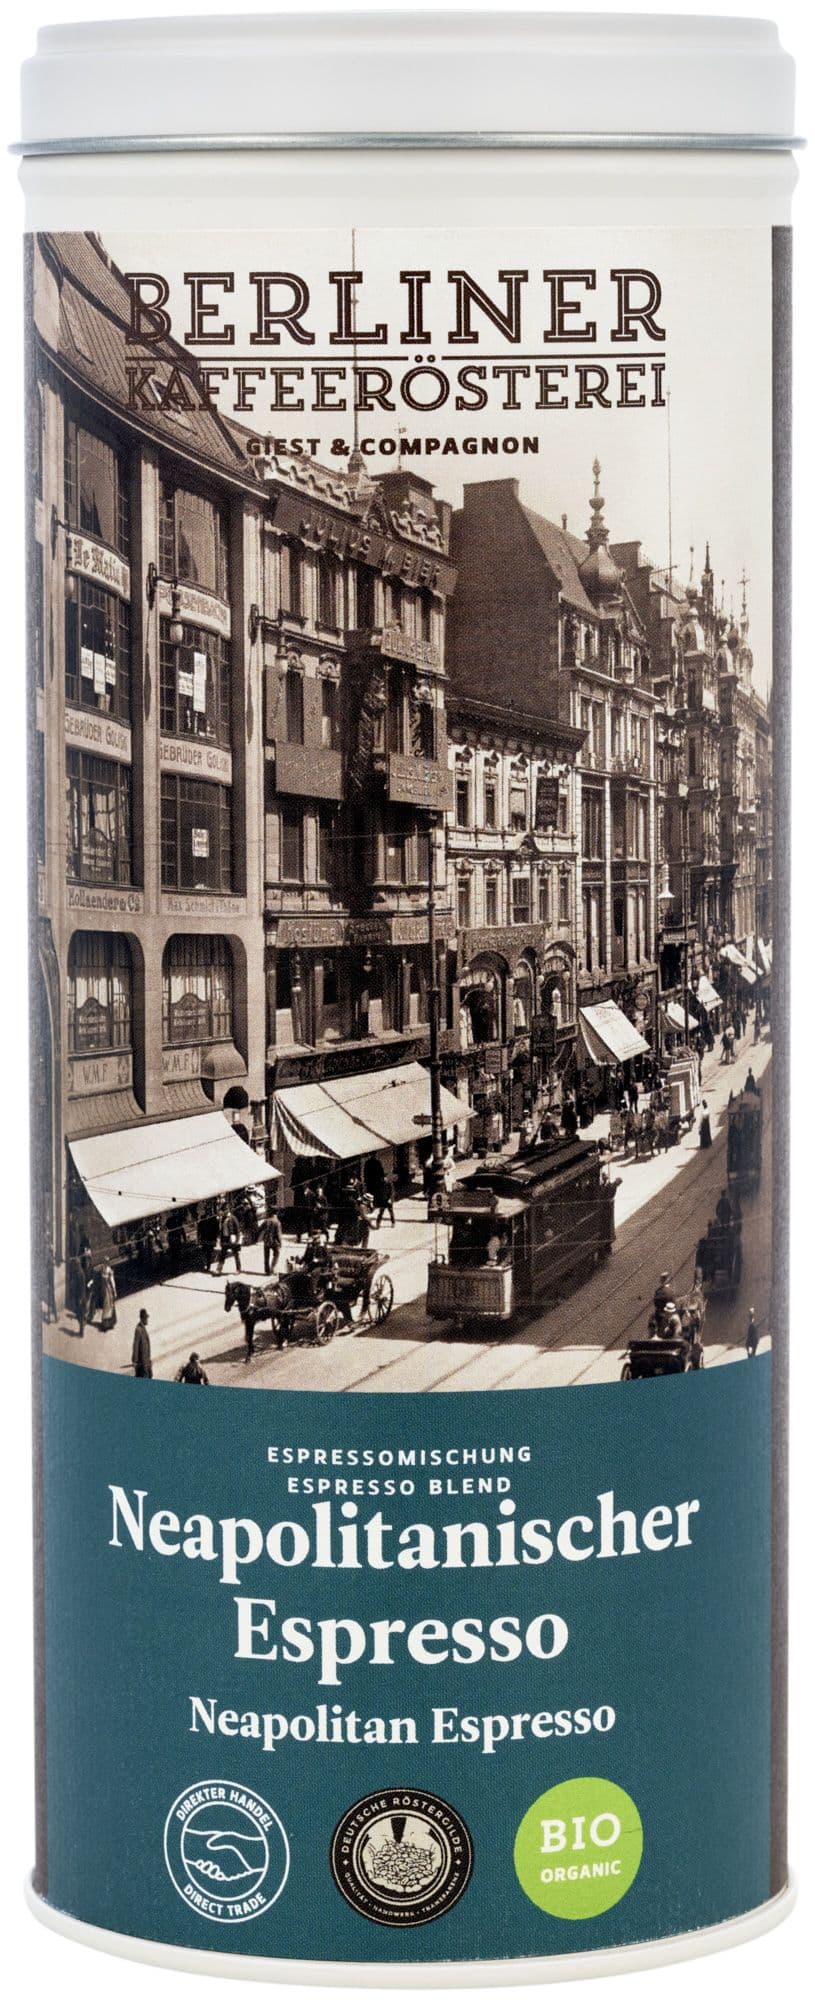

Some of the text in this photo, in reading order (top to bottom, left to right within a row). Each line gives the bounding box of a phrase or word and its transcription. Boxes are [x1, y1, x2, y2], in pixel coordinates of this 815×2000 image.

[124, 269, 666, 345] BERLINER
[125, 354, 666, 412] KAFFEERÖSTEREI
[246, 436, 540, 457] GIEST & COMPAGNON
[267, 1446, 531, 1466] ESPRESSOMISCHUNG
[287, 1476, 511, 1496] ESPRESSO BLEND
[109, 1485, 700, 1585] Neapolitanischer
[234, 1597, 568, 1685] Espresso
[189, 1697, 616, 1753] Neapolitan Espresso
[176, 1787, 273, 1832] DIREKTER HANDEL
[341, 1796, 463, 1854] DEUTSCHE RÖSTERGILDE
[540, 1812, 621, 1853] BIO
[540, 1860, 621, 1884] ORGANIC
[183, 1883, 266, 1916] DIRECT TRADE
